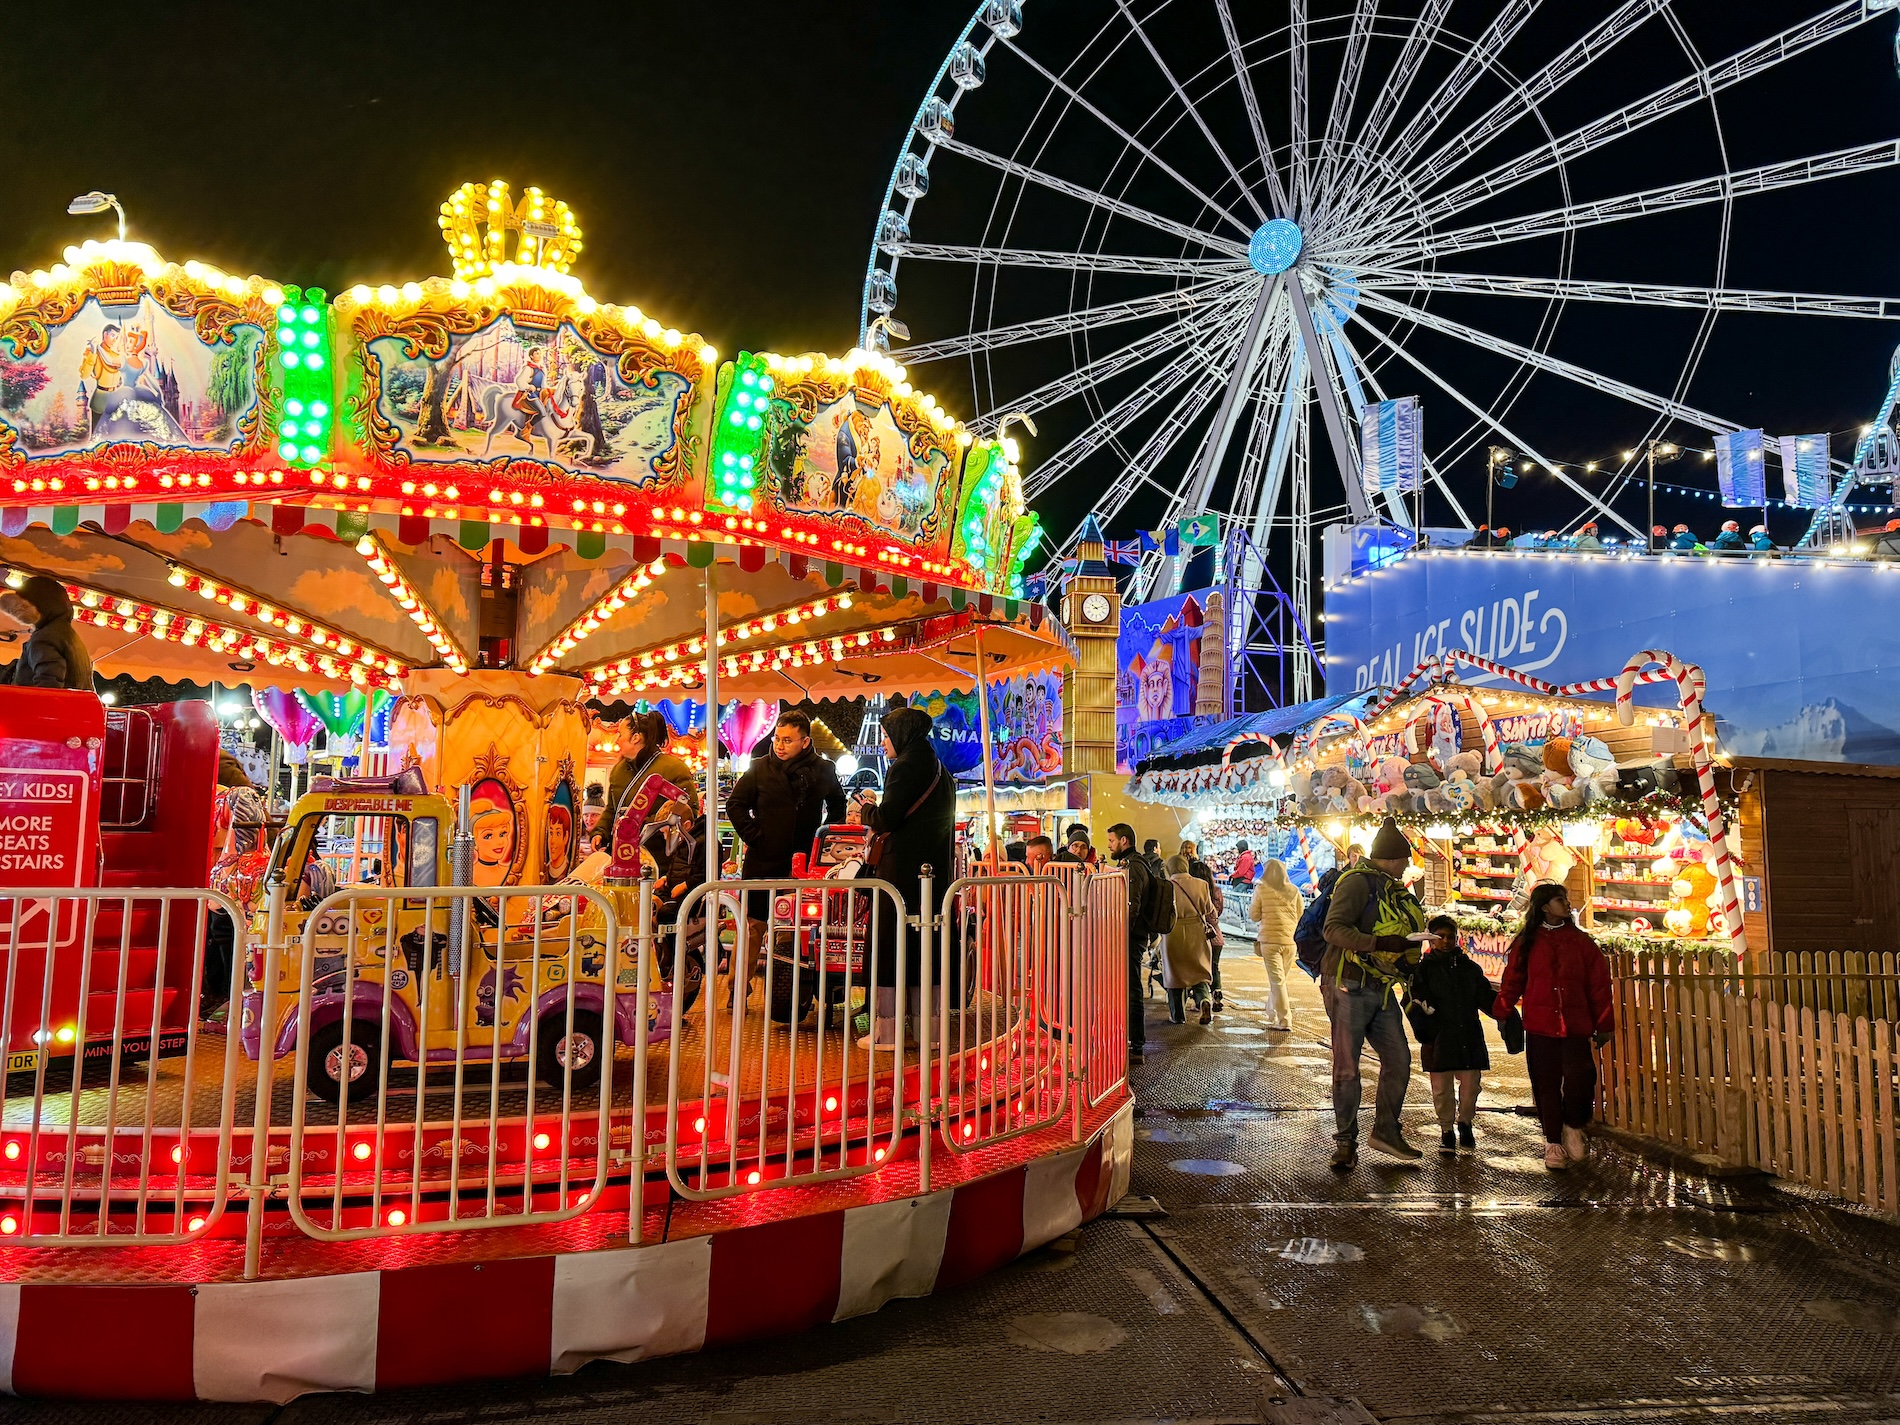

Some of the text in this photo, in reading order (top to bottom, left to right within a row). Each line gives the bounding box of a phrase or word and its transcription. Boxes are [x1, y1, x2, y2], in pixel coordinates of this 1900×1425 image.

[1459, 589, 1540, 670] SLIDE
[940, 727, 998, 744] SMAL
[1501, 713, 1563, 743] SANTA'S
[853, 745, 885, 756] PARIS
[23, 783, 73, 799] KIDS!
[324, 798, 413, 811] DESPICABLE ME
[85, 1038, 186, 1058] MIN YOU STEP
